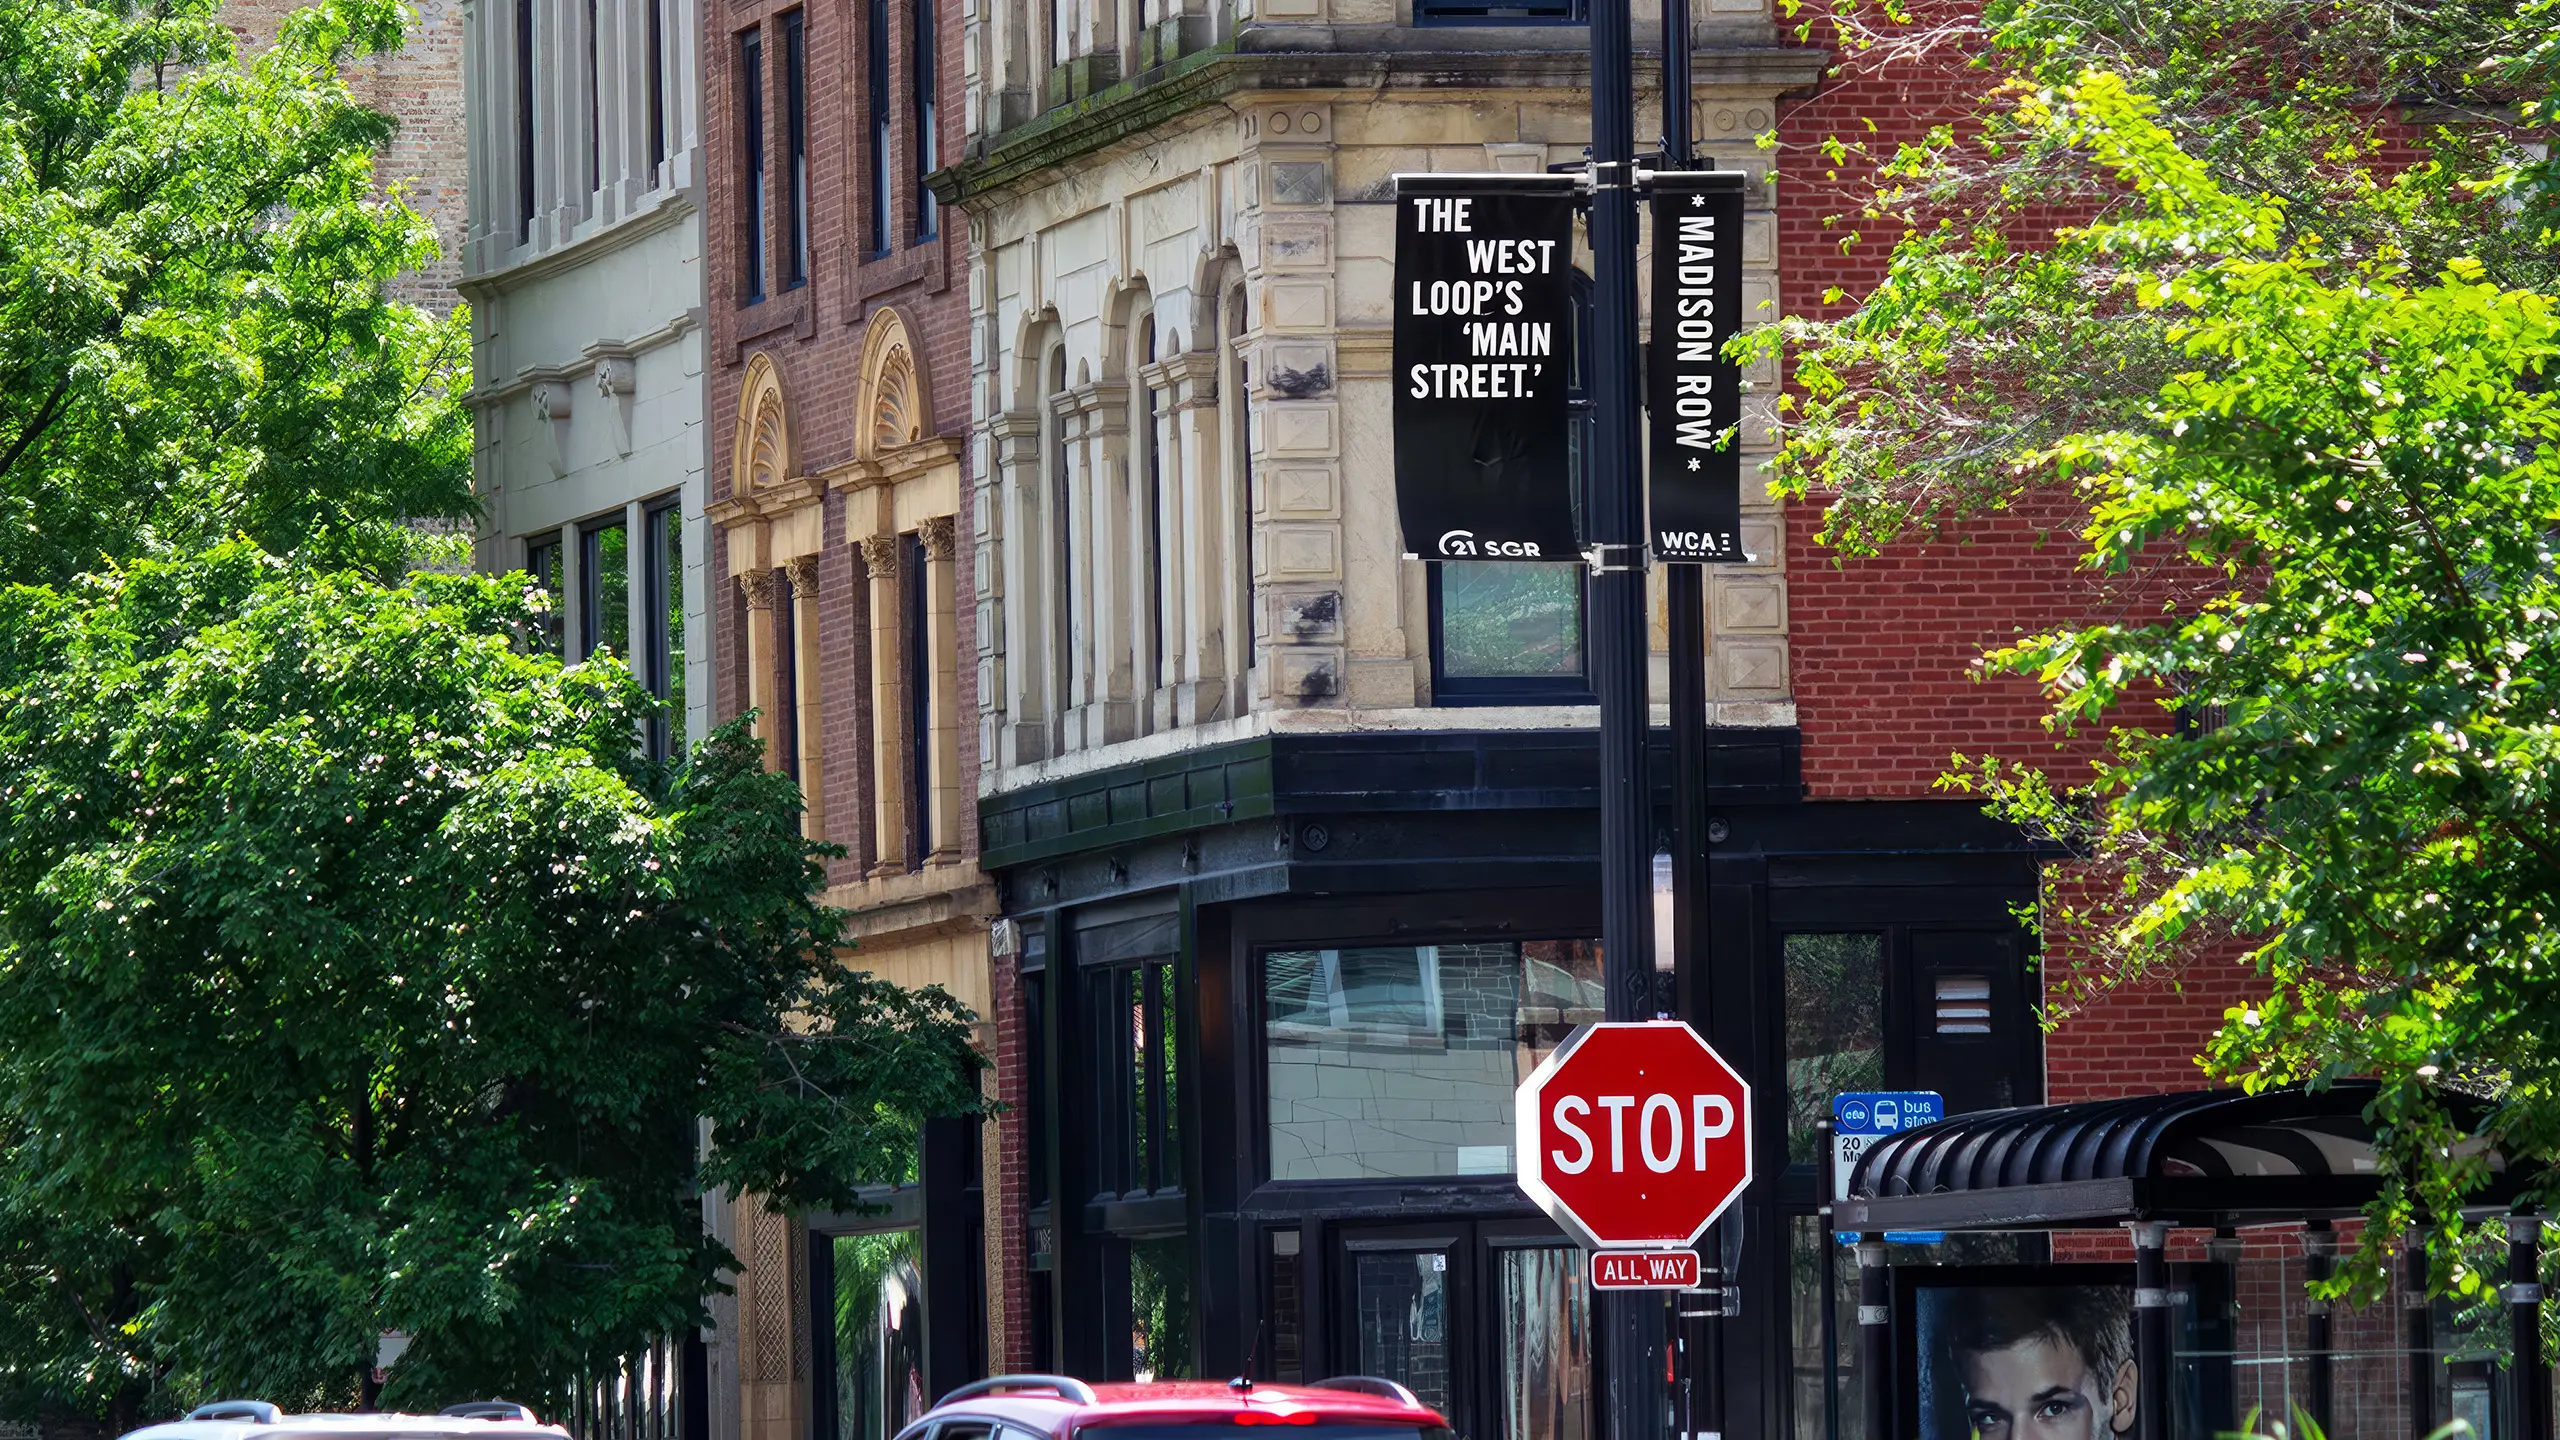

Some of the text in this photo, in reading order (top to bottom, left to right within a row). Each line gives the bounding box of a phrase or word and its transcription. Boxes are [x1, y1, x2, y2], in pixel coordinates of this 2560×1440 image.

[1413, 198, 1472, 233] THE
[1466, 239, 1556, 274] WEST
[1412, 280, 1524, 316] LOOP’S
[1675, 215, 1715, 450] MADISON ROW
[1484, 540, 1541, 557] SGR
[1903, 1099, 1932, 1114] bus
[1551, 1093, 1735, 1175] STOP
[1842, 1136, 1861, 1150] 20
[1603, 1258, 1688, 1281] ALL WAY
